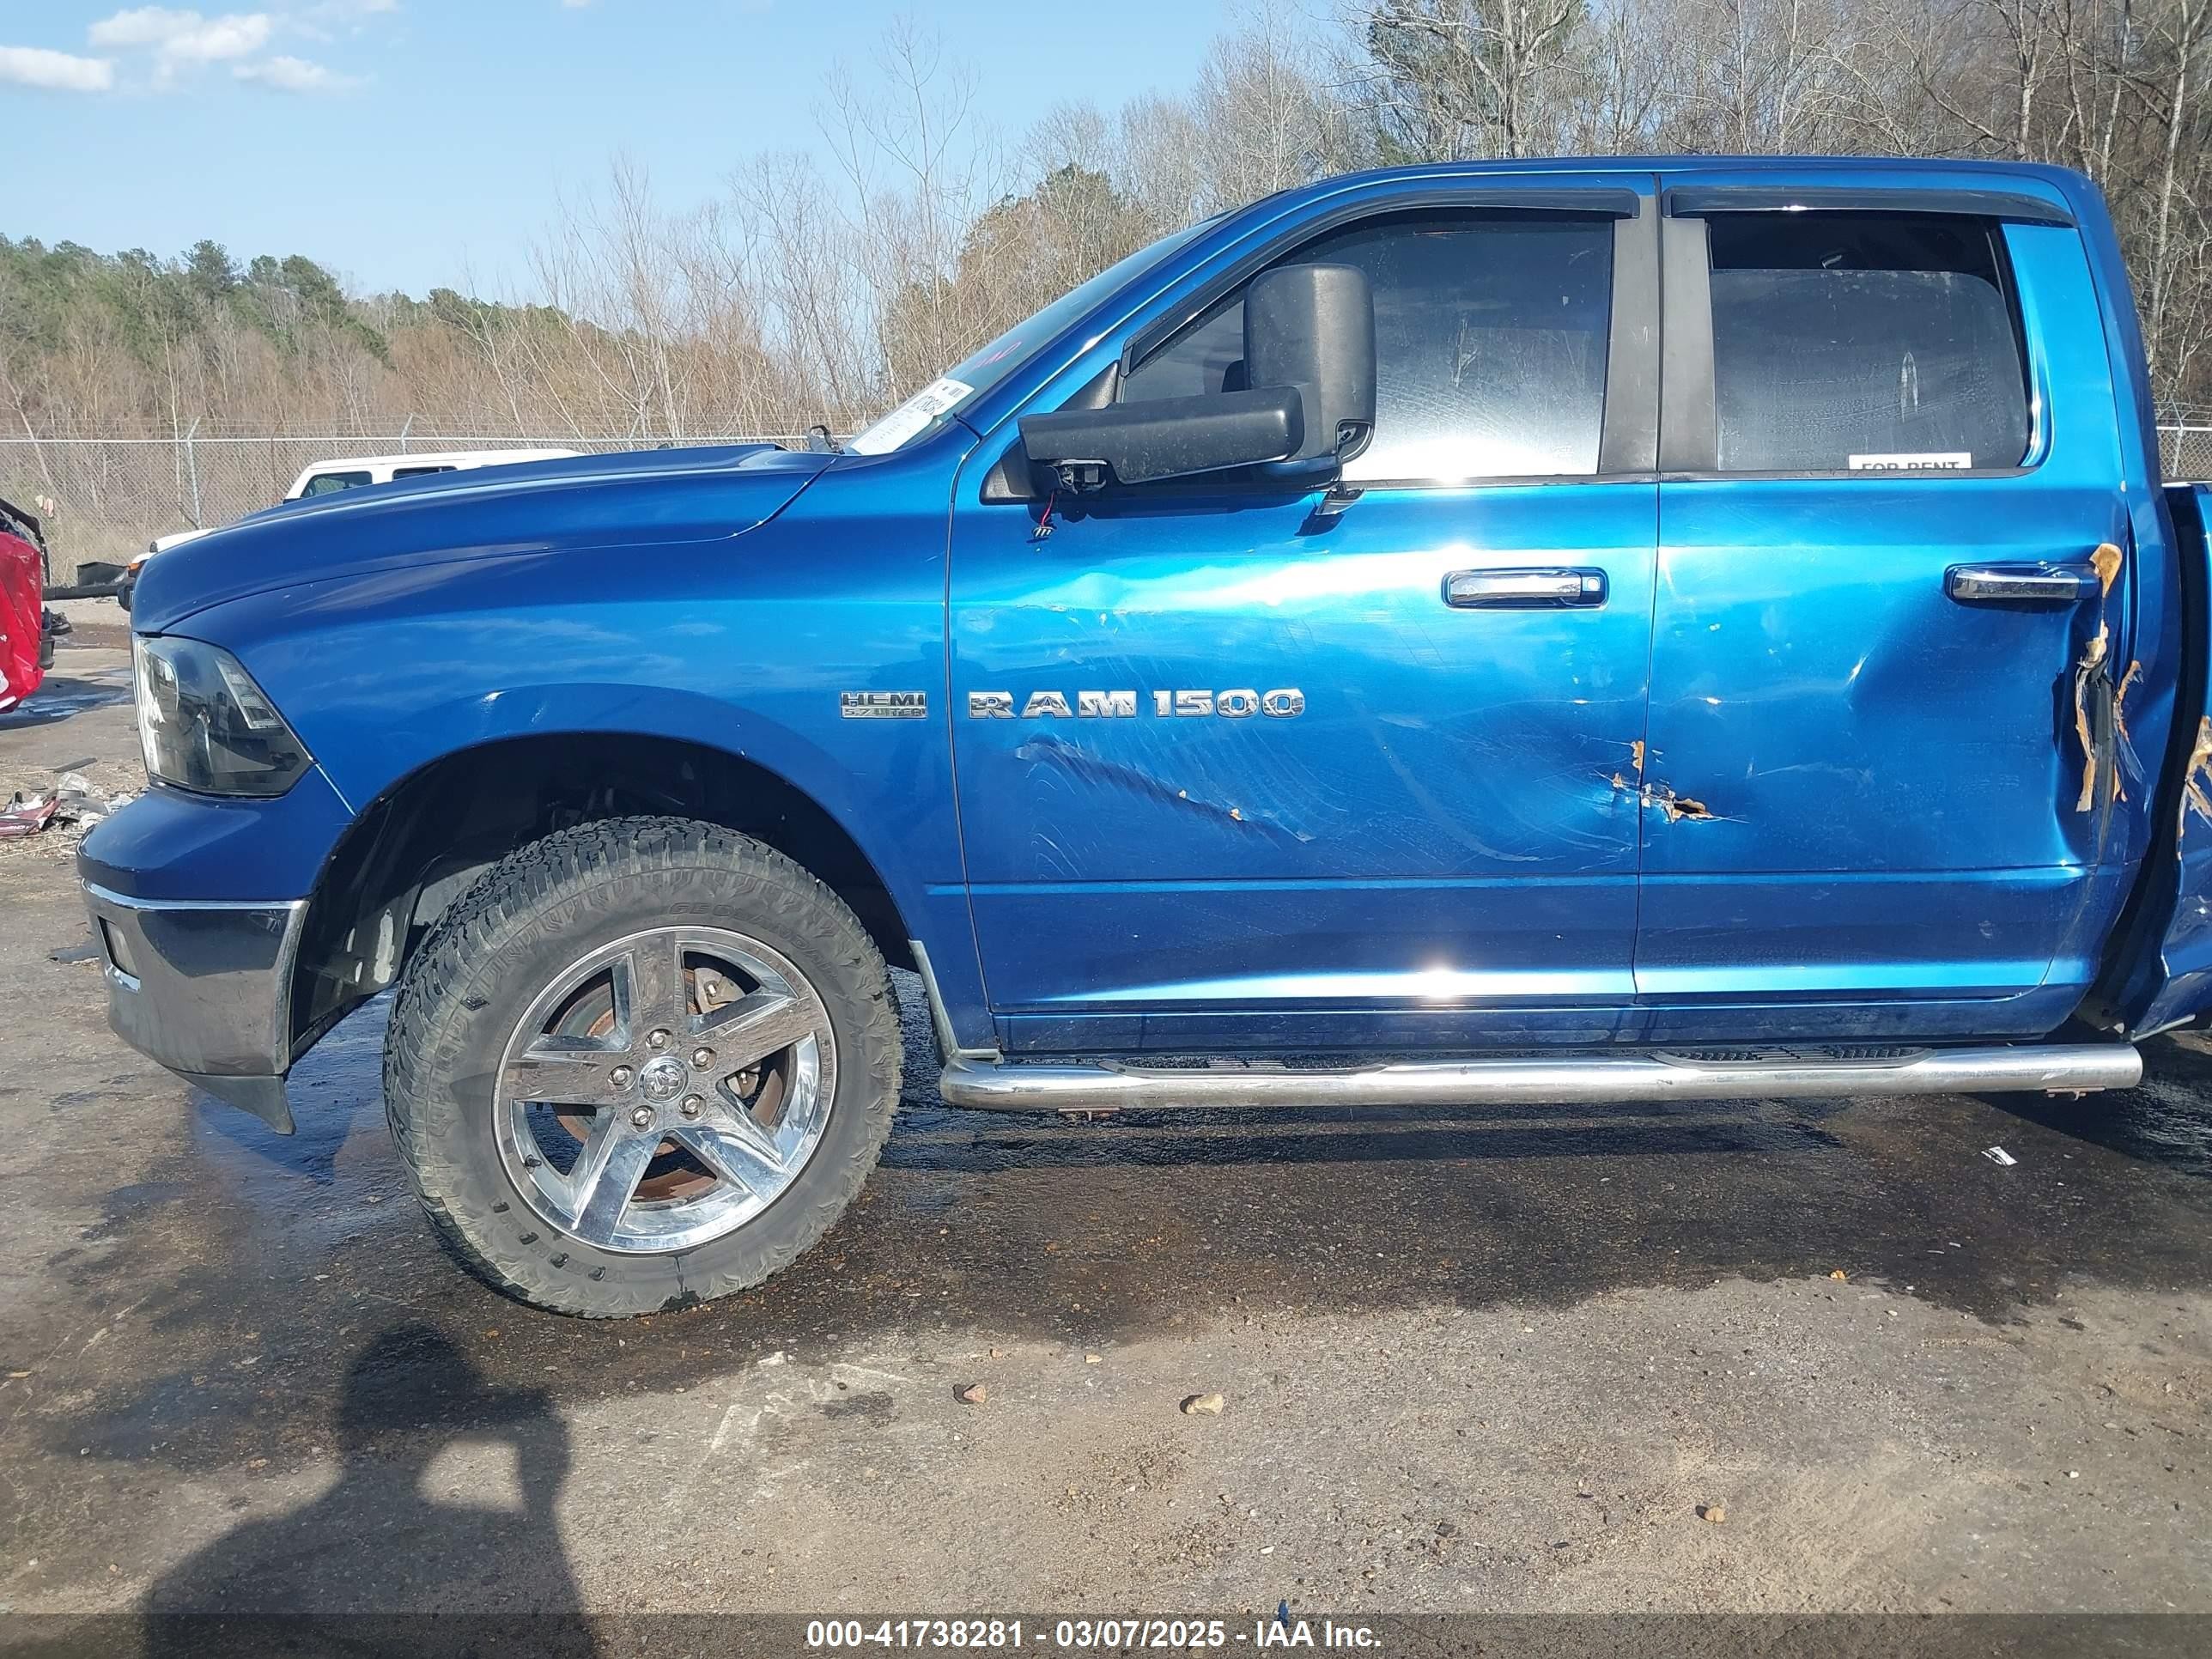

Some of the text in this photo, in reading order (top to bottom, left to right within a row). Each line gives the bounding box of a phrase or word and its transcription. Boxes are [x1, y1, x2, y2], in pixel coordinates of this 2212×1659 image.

[842, 692, 927, 707] HEMI
[968, 689, 1306, 719] RAM 1500
